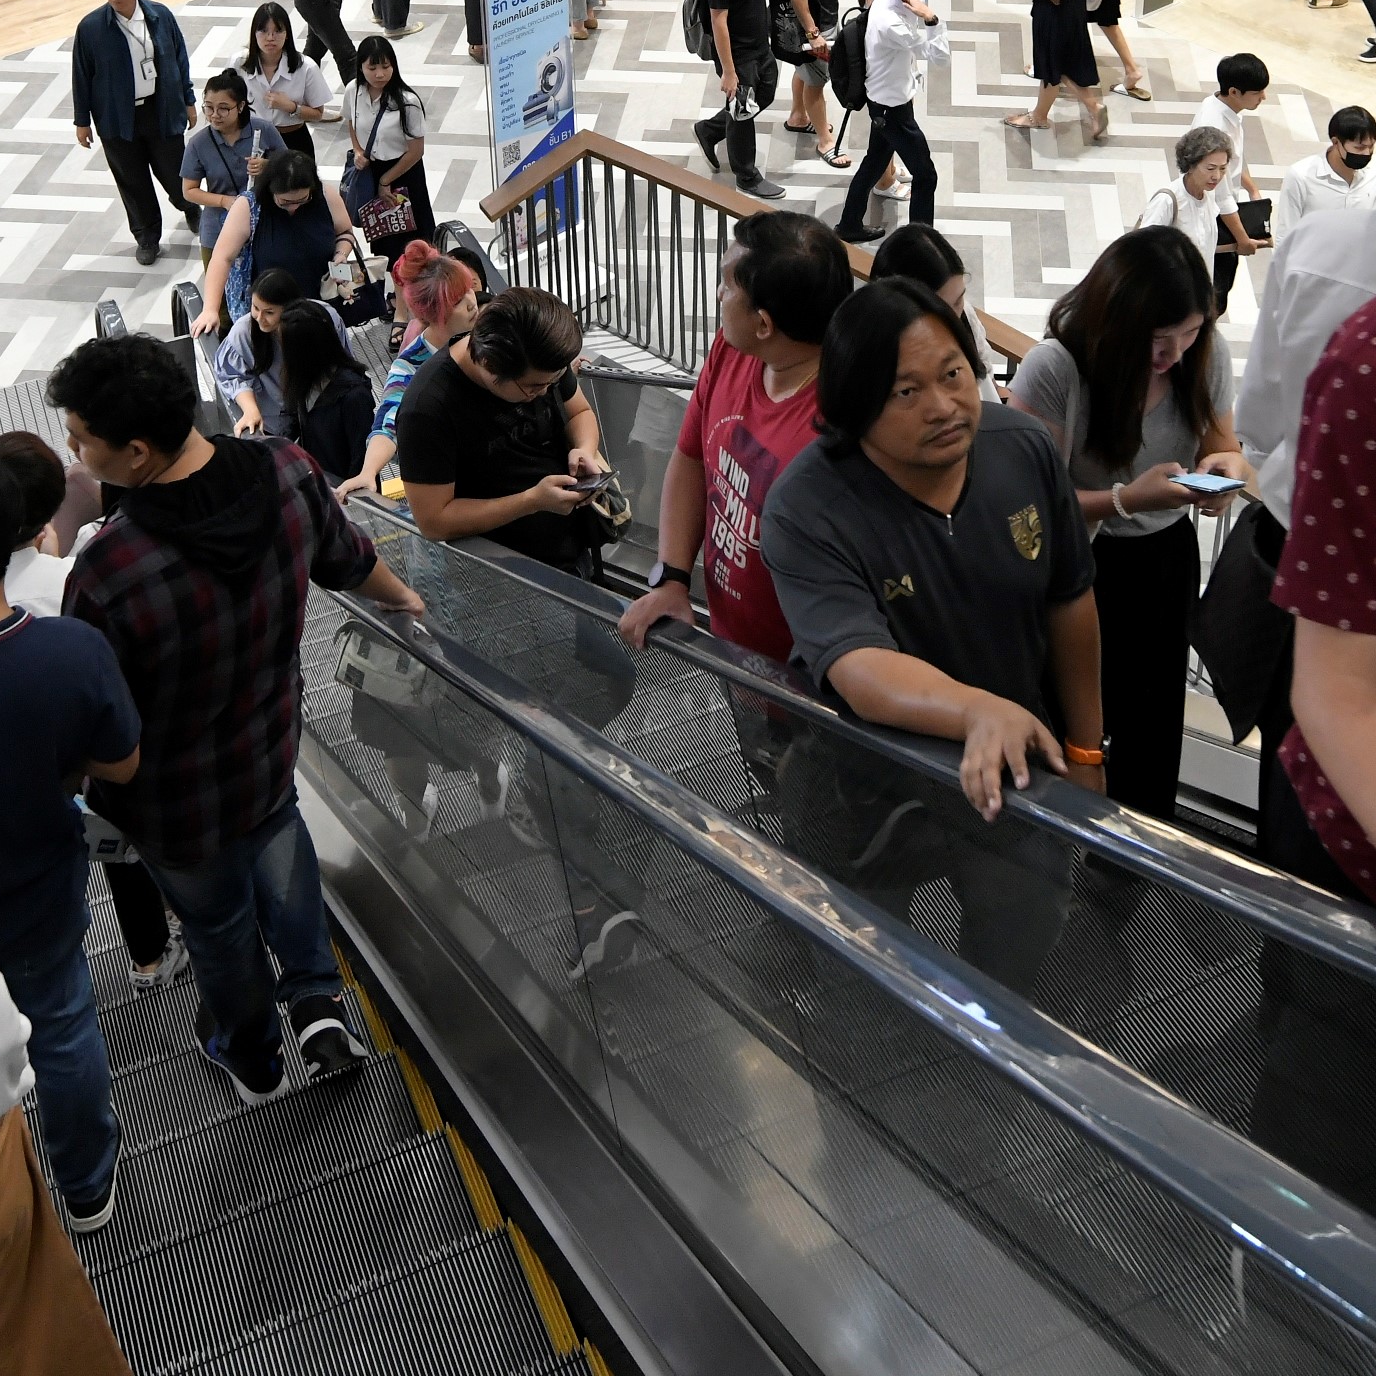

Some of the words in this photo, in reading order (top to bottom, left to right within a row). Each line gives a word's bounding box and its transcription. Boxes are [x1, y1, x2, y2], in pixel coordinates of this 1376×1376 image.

[491, 0, 508, 16] ซัก
[492, 2, 539, 30] ด้วยเทคโนโลยี
[560, 129, 573, 142] B1
[718, 446, 750, 500] WIND
[725, 488, 760, 546] MILL
[711, 514, 748, 569] 1995
